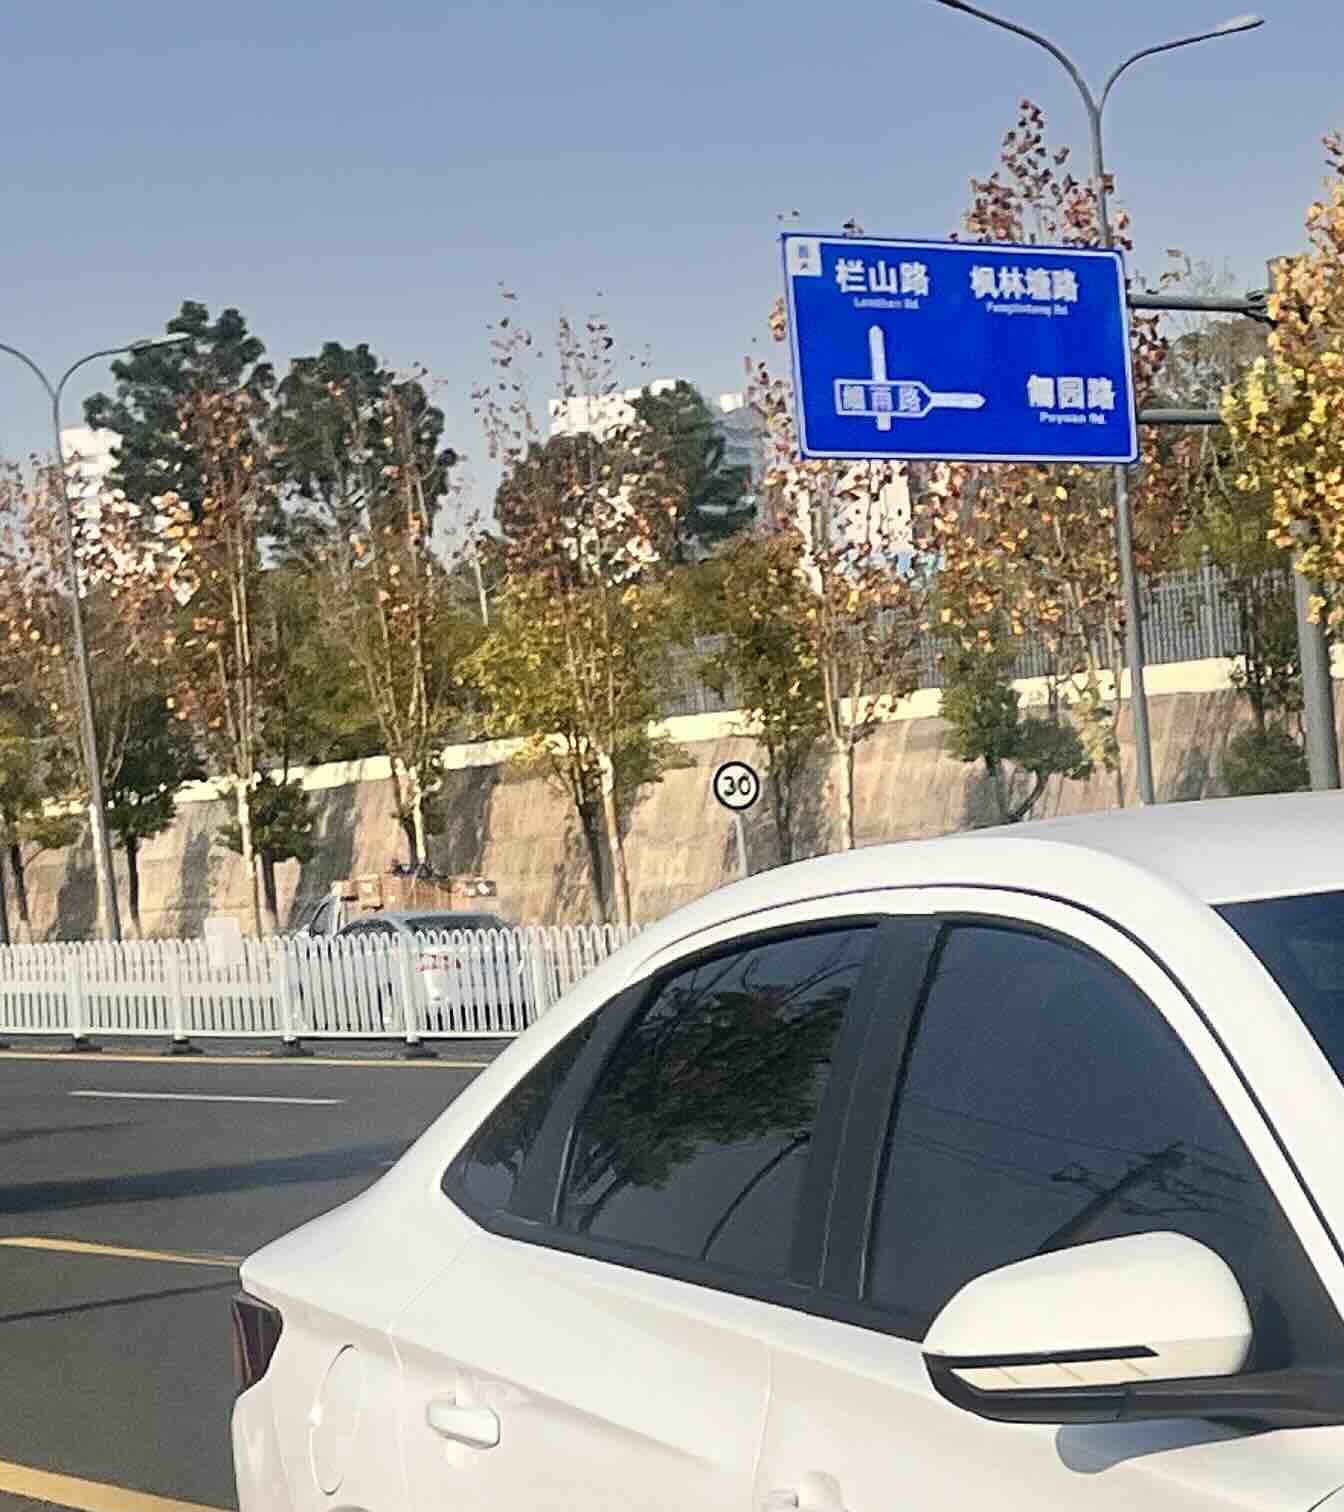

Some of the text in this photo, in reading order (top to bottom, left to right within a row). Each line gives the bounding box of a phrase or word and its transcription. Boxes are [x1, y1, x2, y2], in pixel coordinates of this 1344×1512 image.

[835, 258, 930, 296] 栏山路
[723, 774, 751, 796] 30
